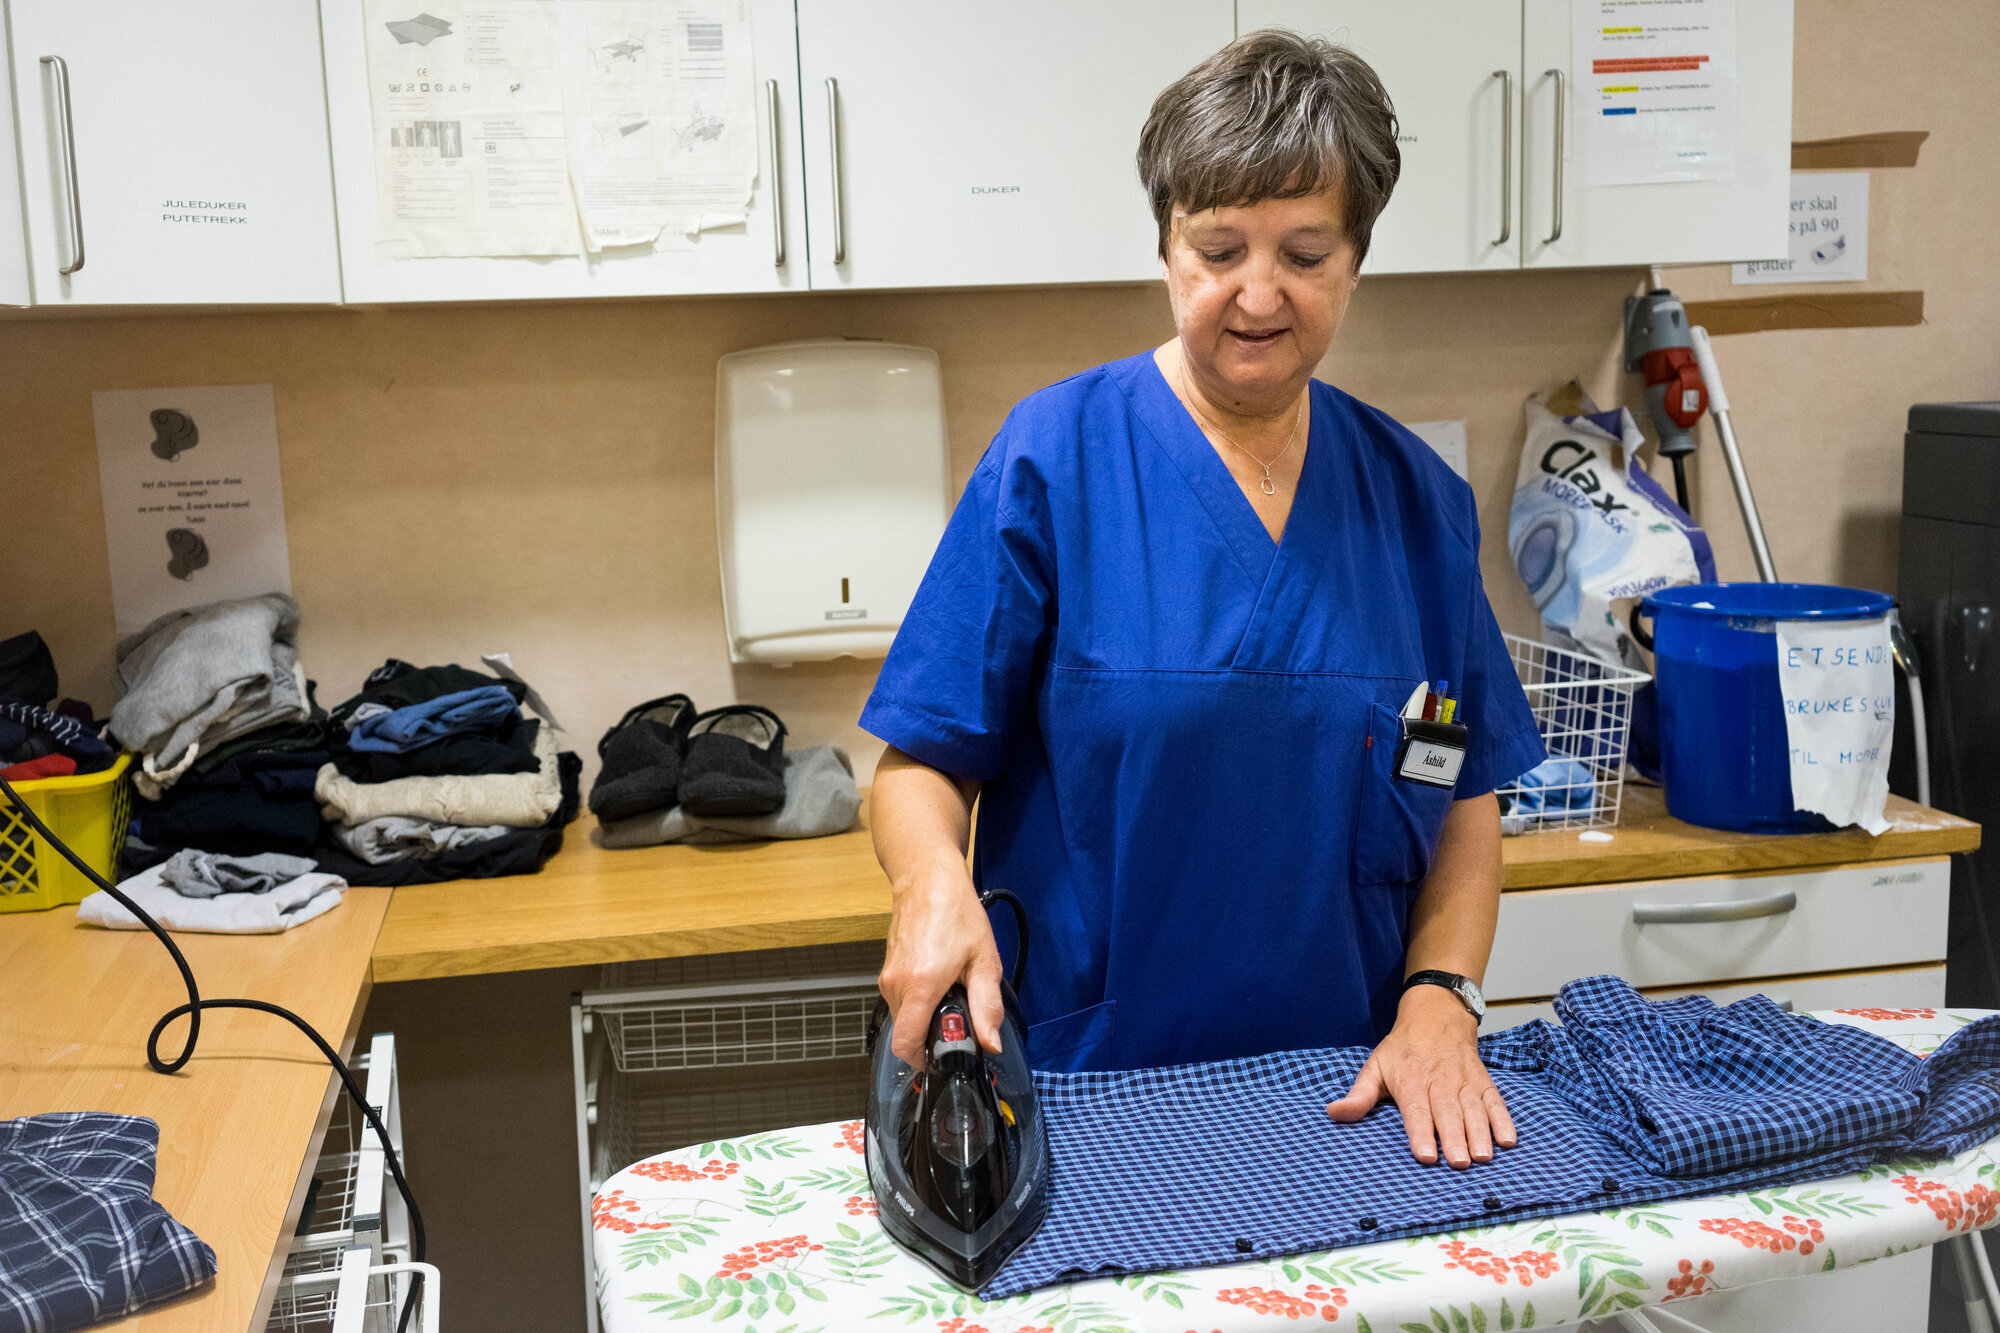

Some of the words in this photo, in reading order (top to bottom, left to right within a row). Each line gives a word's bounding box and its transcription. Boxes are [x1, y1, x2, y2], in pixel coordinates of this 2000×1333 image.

[971, 186, 1021, 194] DUKER
[162, 200, 247, 210] JULEDUKER
[1790, 199, 1807, 211] er
[1809, 195, 1838, 211] skal
[162, 214, 247, 224] PUTETREKK
[1789, 221, 1797, 233] s
[1800, 217, 1817, 236] på
[1821, 218, 1839, 233] 90
[141, 480, 154, 489] Vet
[157, 480, 166, 488] du
[168, 479, 187, 487] hvem
[1541, 440, 1630, 512] Clax
[1786, 696, 1868, 715] BRUKES
[1422, 750, 1447, 768] Åshild
[1790, 748, 1818, 765] TIL
[894, 1190, 916, 1217] PHILIPS
[1014, 1182, 1032, 1210] PHILIPS
